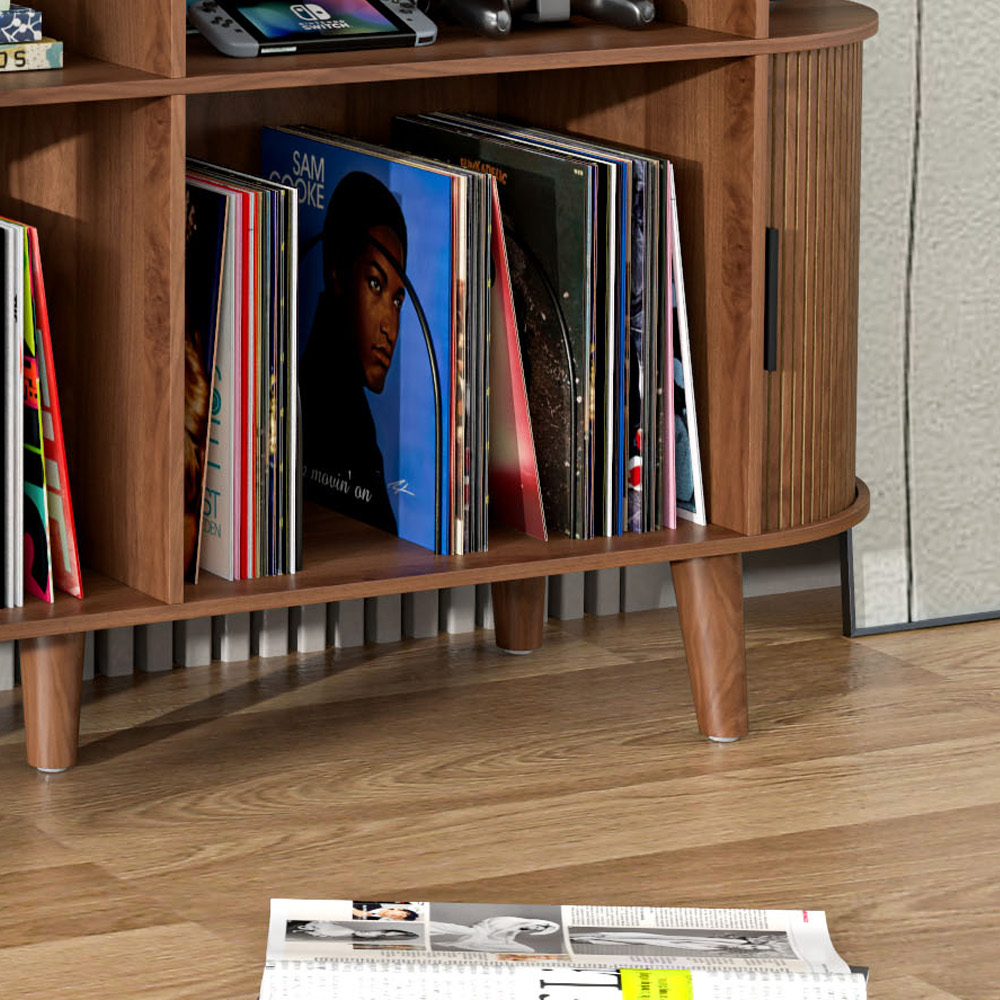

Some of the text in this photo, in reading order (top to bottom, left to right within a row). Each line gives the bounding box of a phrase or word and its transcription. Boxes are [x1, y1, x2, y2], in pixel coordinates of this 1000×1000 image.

[302, 22, 351, 31] SWITCH
[292, 150, 325, 183] SAM
[354, 485, 373, 503] on
